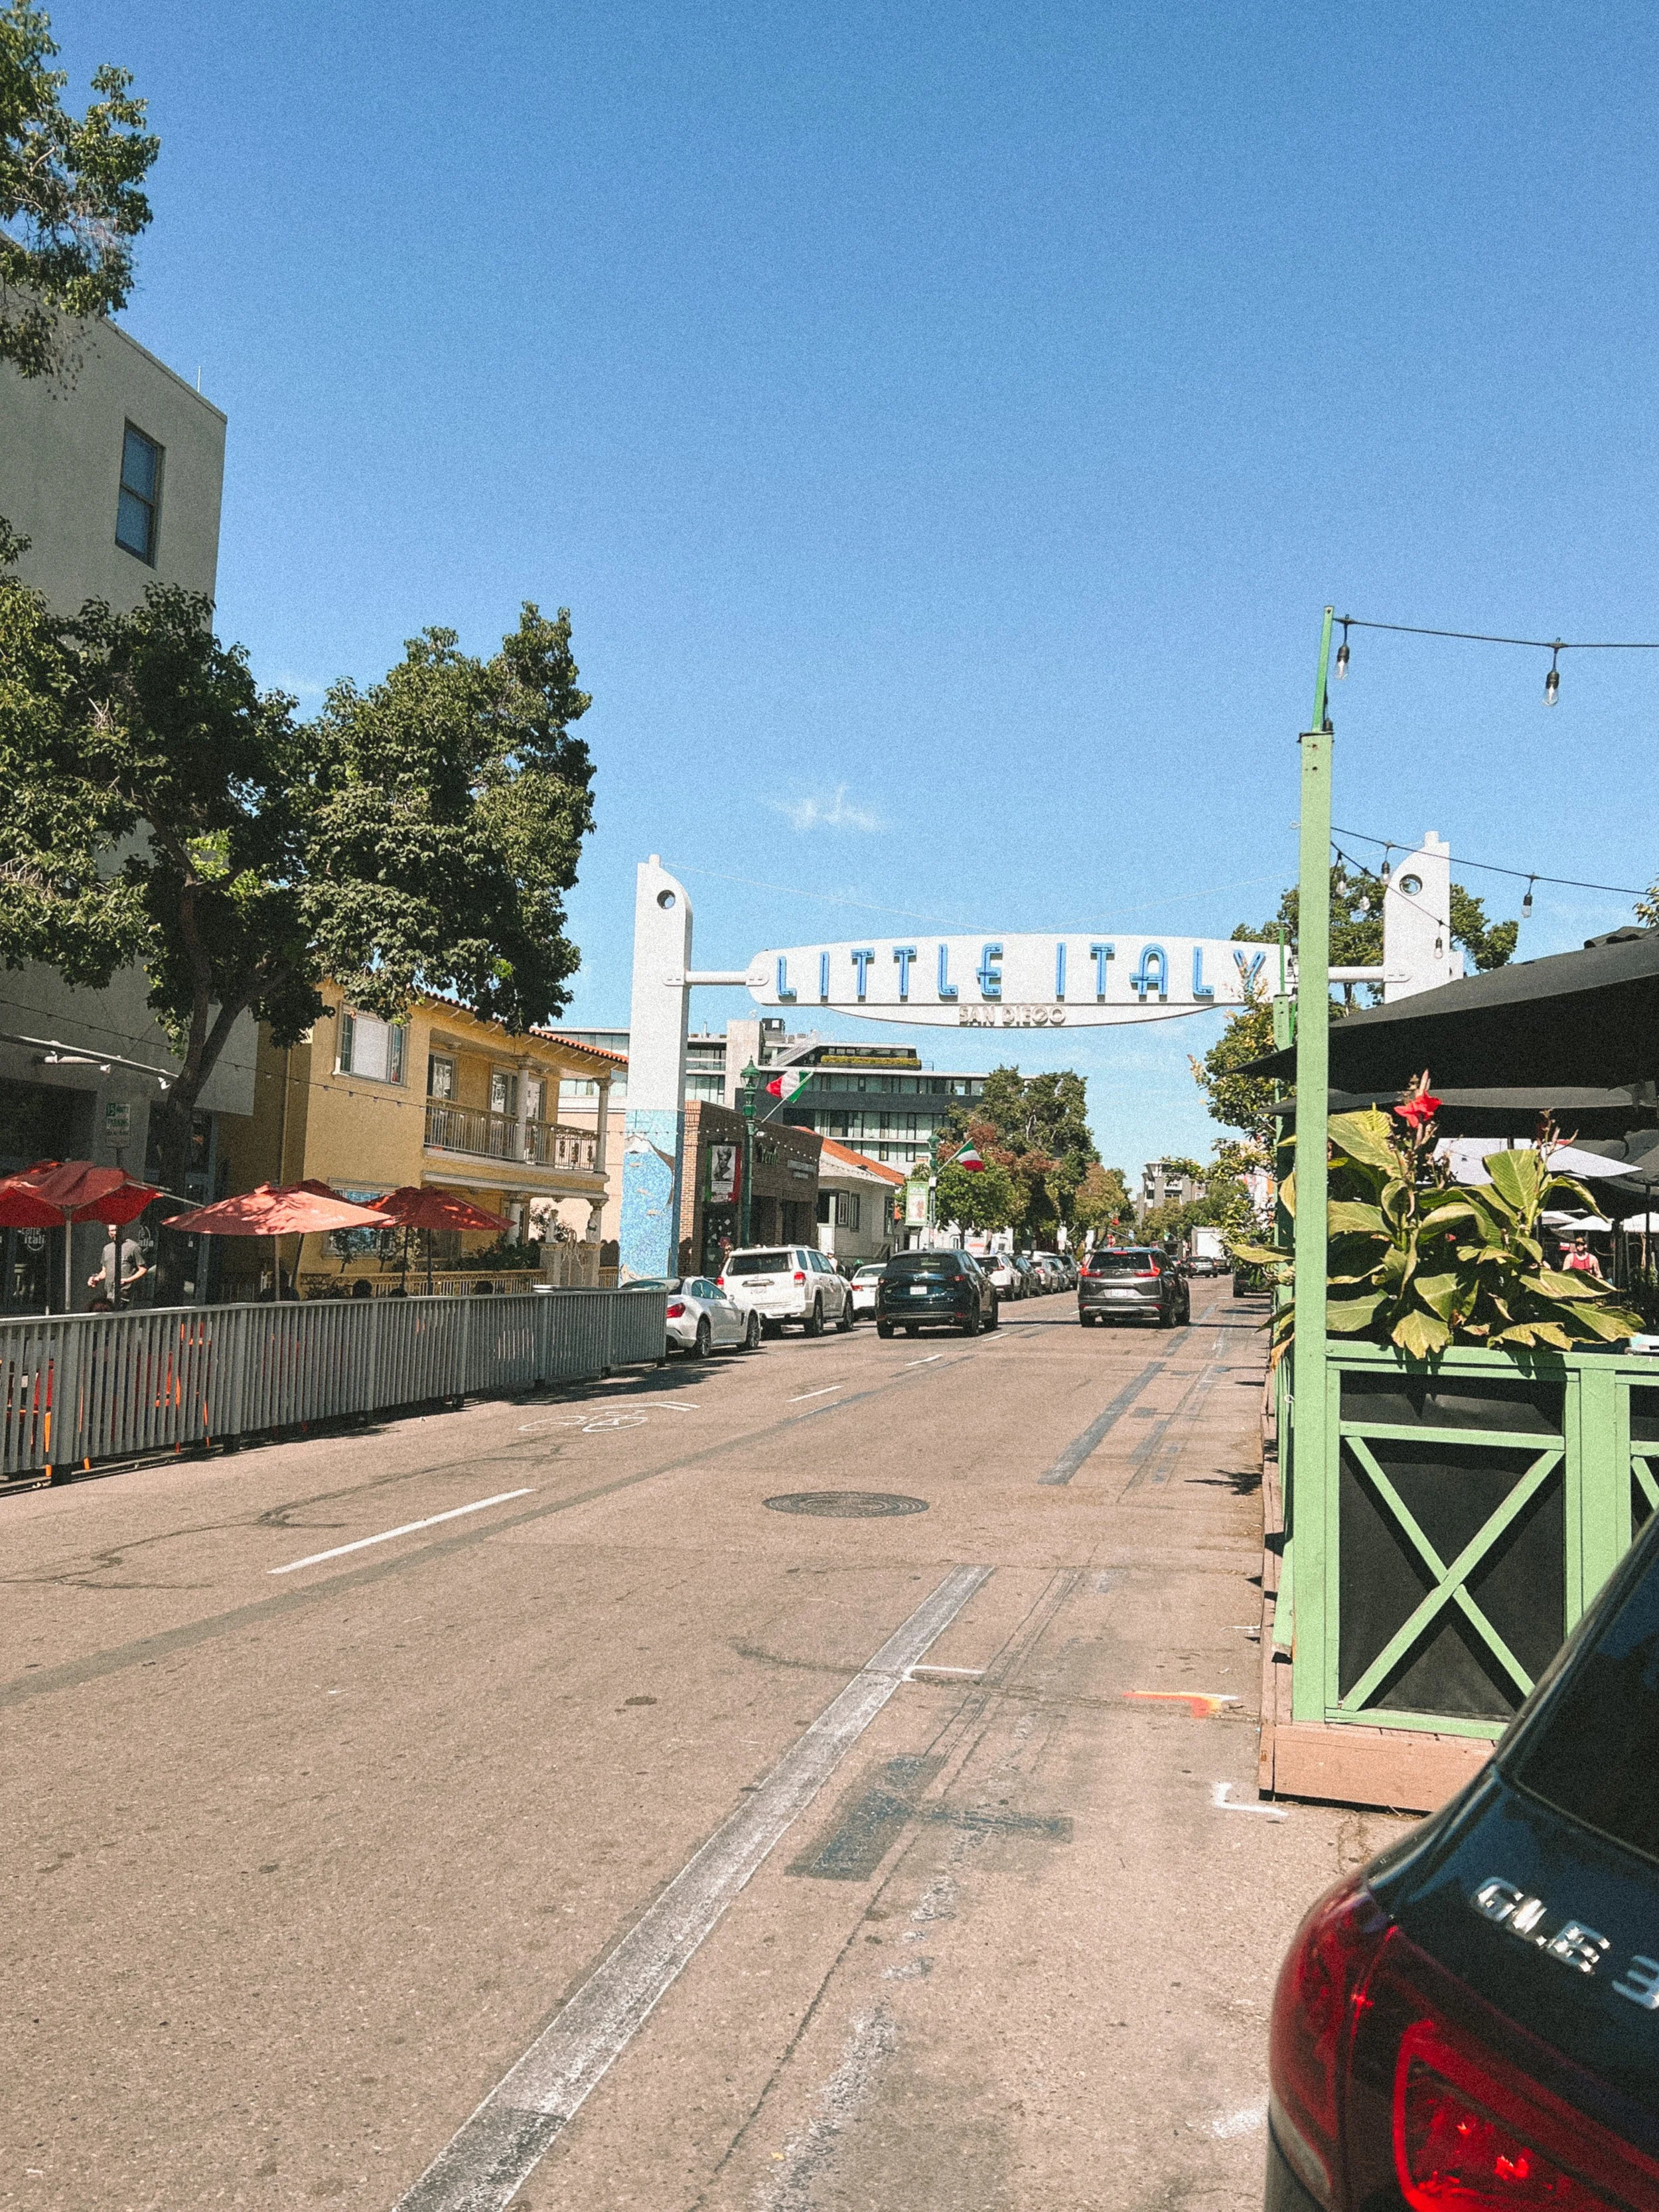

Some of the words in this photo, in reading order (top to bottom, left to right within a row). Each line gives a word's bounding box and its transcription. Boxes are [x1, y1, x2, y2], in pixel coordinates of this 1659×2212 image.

[776, 942, 1003, 996] LITTLE
[1055, 942, 1266, 995] ITALY
[959, 1004, 995, 1024] SAN
[1003, 1004, 1066, 1024] DIEGO
[24, 1234, 45, 1244] itali
[1470, 1876, 1611, 1974] GLE
